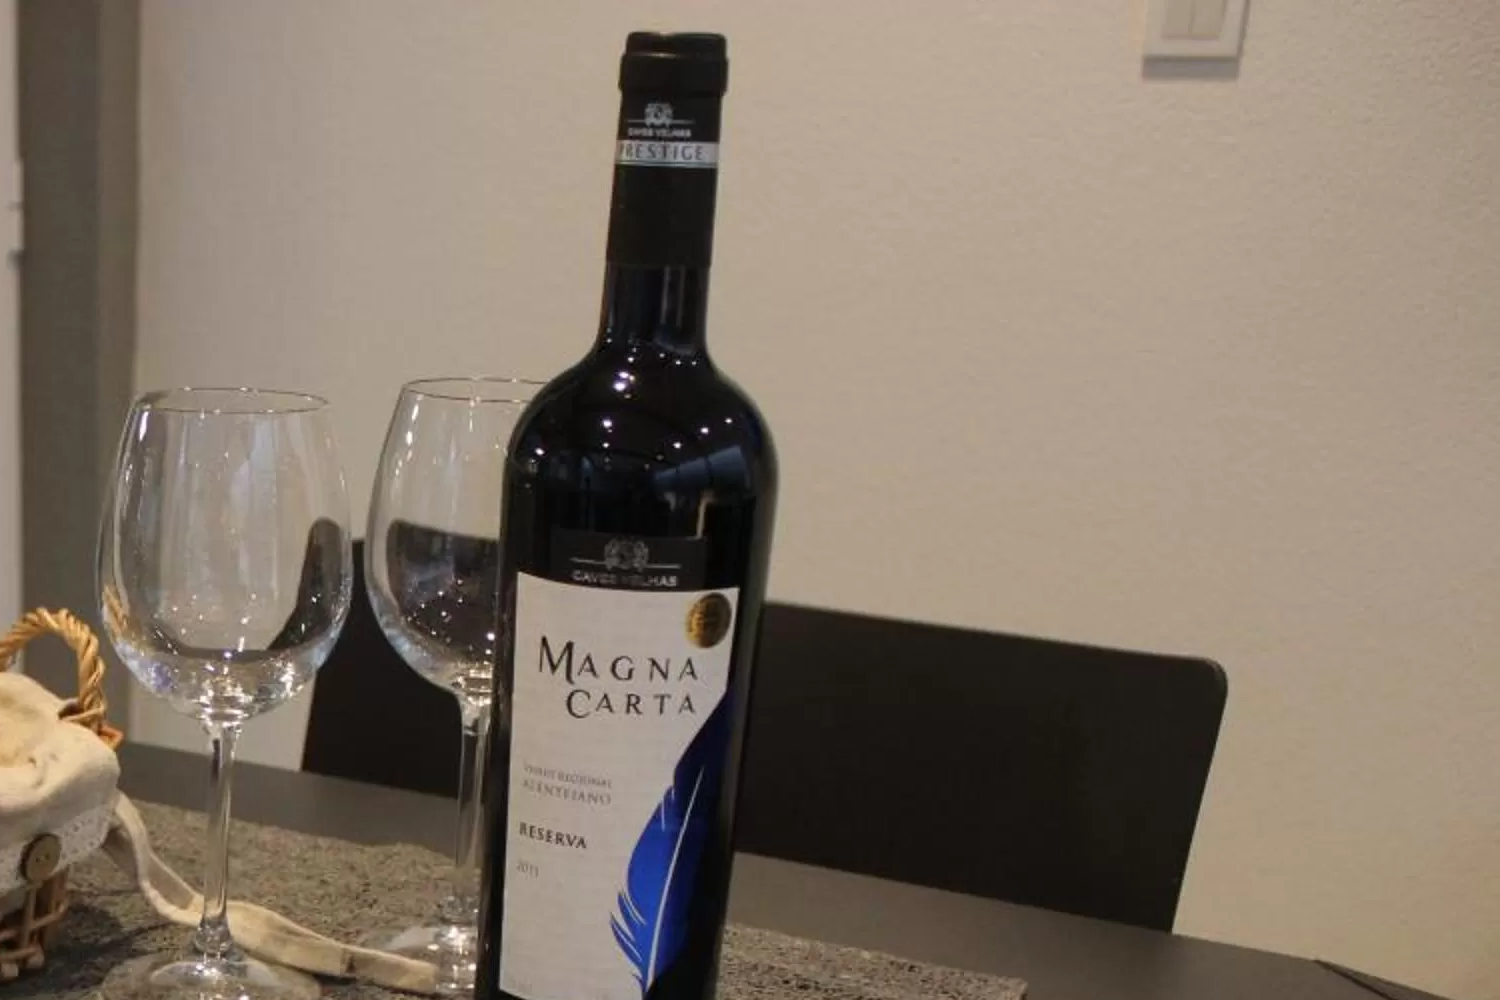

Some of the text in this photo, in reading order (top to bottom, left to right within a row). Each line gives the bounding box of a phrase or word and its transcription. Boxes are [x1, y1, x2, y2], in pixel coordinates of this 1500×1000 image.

[538, 635, 698, 684] MAGNA
[565, 689, 697, 718] CARTA
[519, 821, 587, 848] RESERVA
